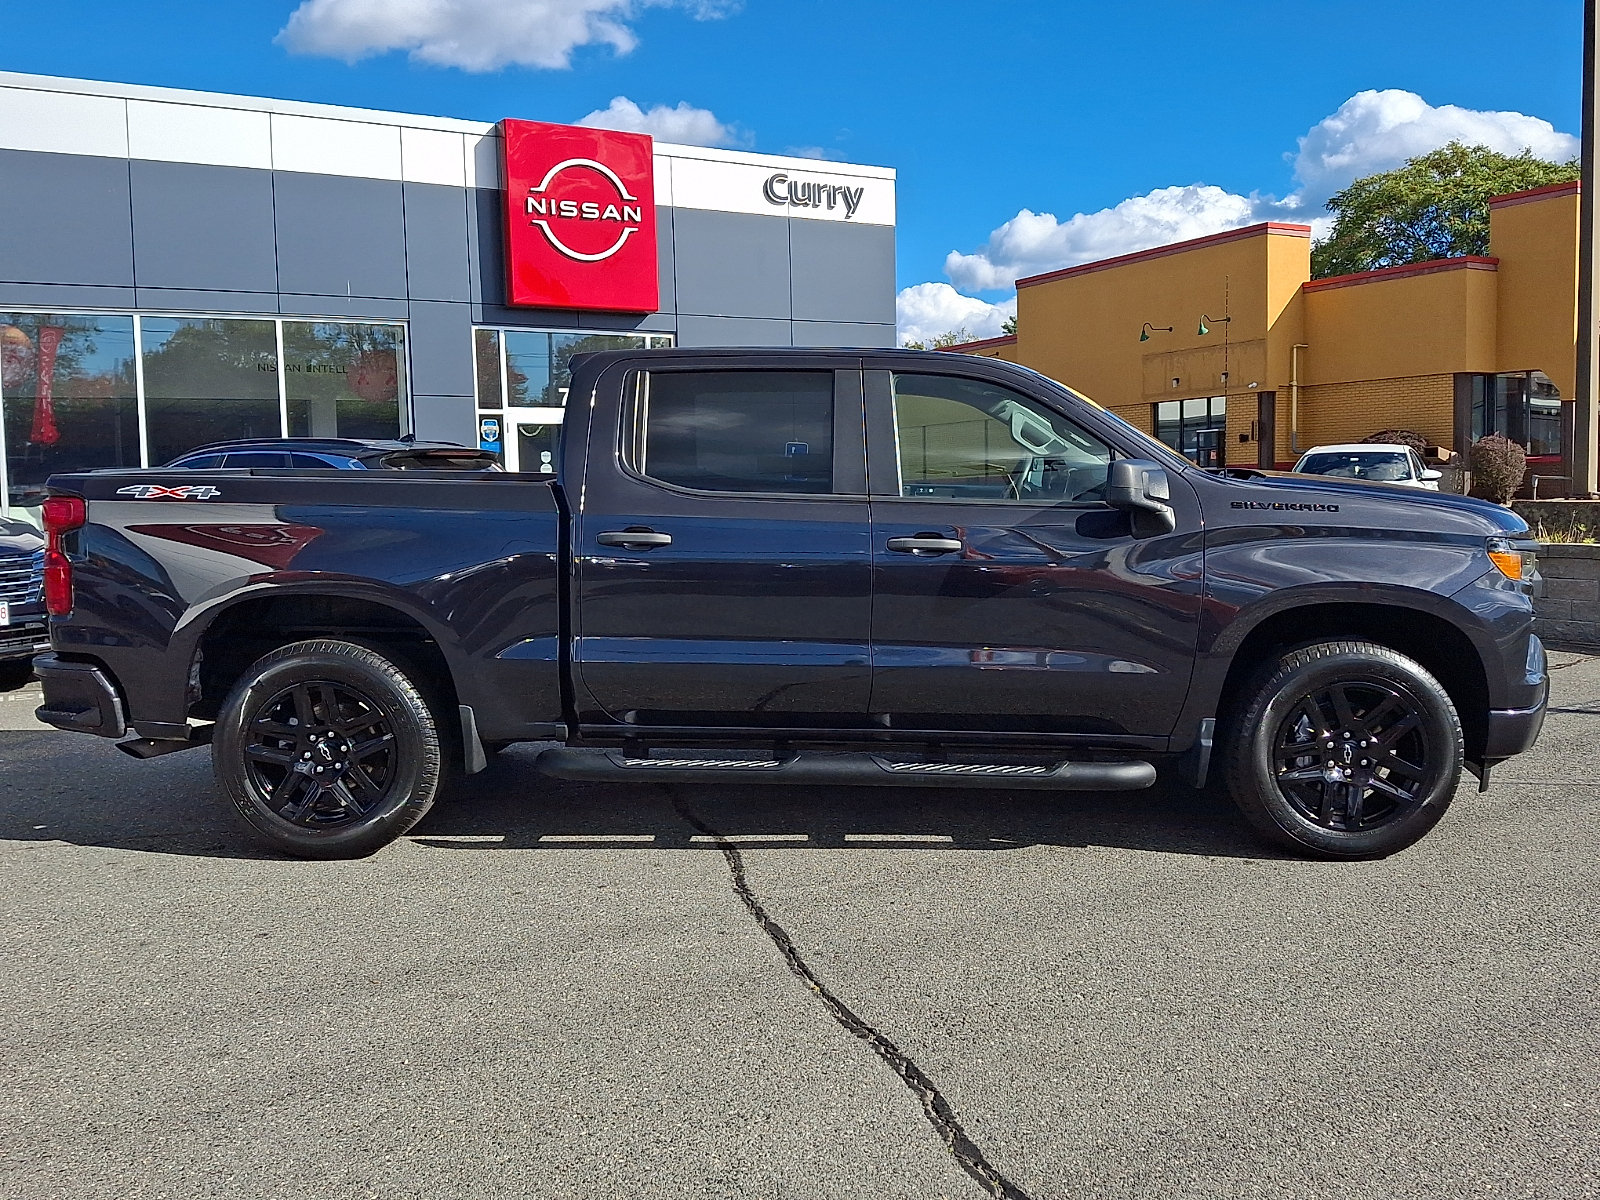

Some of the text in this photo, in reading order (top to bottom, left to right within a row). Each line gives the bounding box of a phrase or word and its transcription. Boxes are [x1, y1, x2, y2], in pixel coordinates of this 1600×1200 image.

[763, 173, 865, 219] Curry
[526, 196, 642, 222] NISSAN
[257, 363, 301, 373] NISAN
[1230, 501, 1340, 513] SILVERADO
